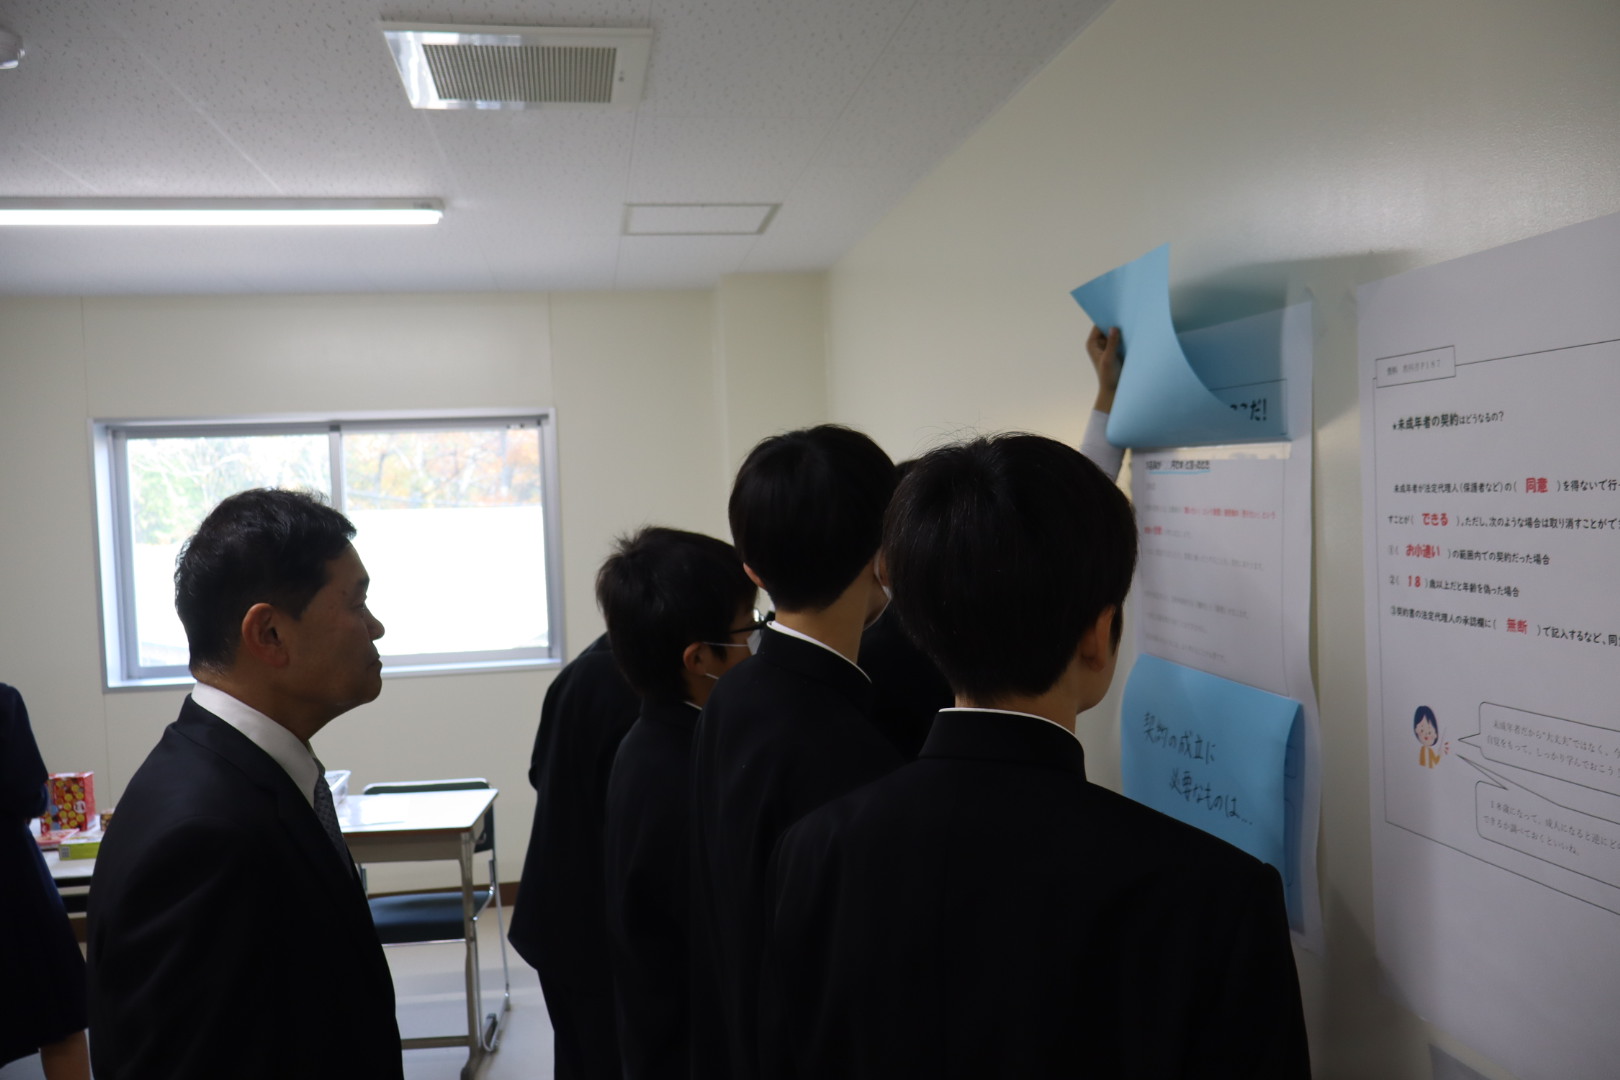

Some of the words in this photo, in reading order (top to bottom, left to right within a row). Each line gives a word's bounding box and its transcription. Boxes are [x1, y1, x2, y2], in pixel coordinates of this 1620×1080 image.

[1525, 476, 1548, 494] 同意
[1557, 479, 1620, 493] )を得ないで行
[1421, 512, 1449, 527] できる
[1407, 575, 1422, 588] 18
[1506, 617, 1529, 635] 無断
[1537, 624, 1620, 647] )で記入するなど、同
[1143, 711, 1217, 766] 契約の成立に
